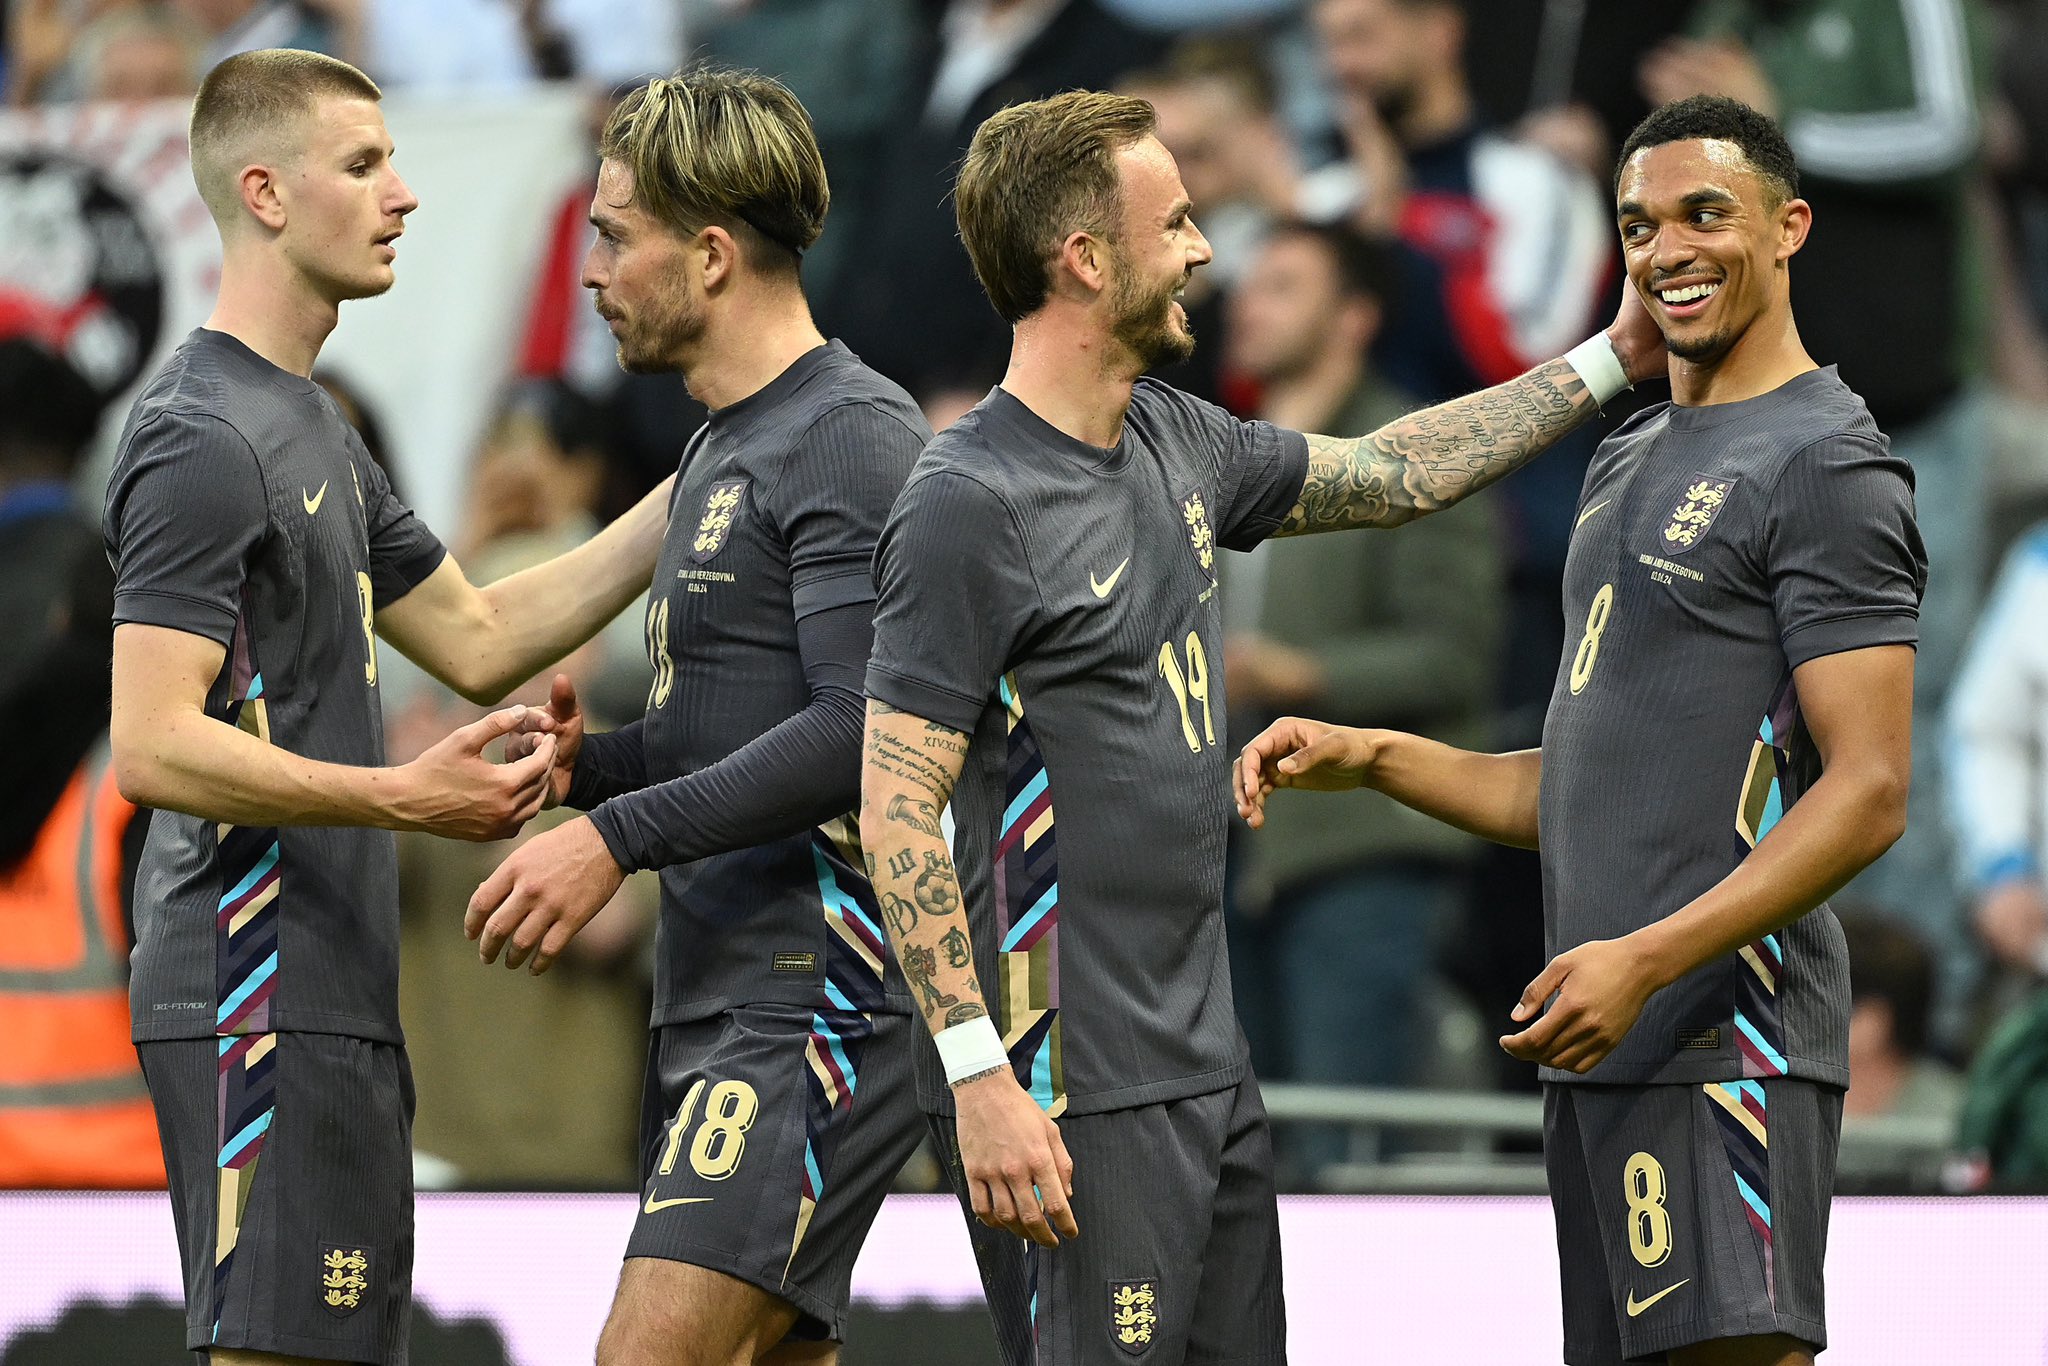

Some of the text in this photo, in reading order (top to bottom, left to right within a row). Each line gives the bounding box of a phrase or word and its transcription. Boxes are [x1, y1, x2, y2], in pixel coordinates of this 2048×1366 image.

[696, 570, 736, 582] HERZEGOVINA
[1662, 560, 1704, 582] HERZEGOVINA
[647, 597, 675, 709] 18
[1158, 631, 1216, 753] 19
[1570, 583, 1613, 696] 8
[659, 1079, 759, 1181] 18
[1623, 1151, 1672, 1268] 8
